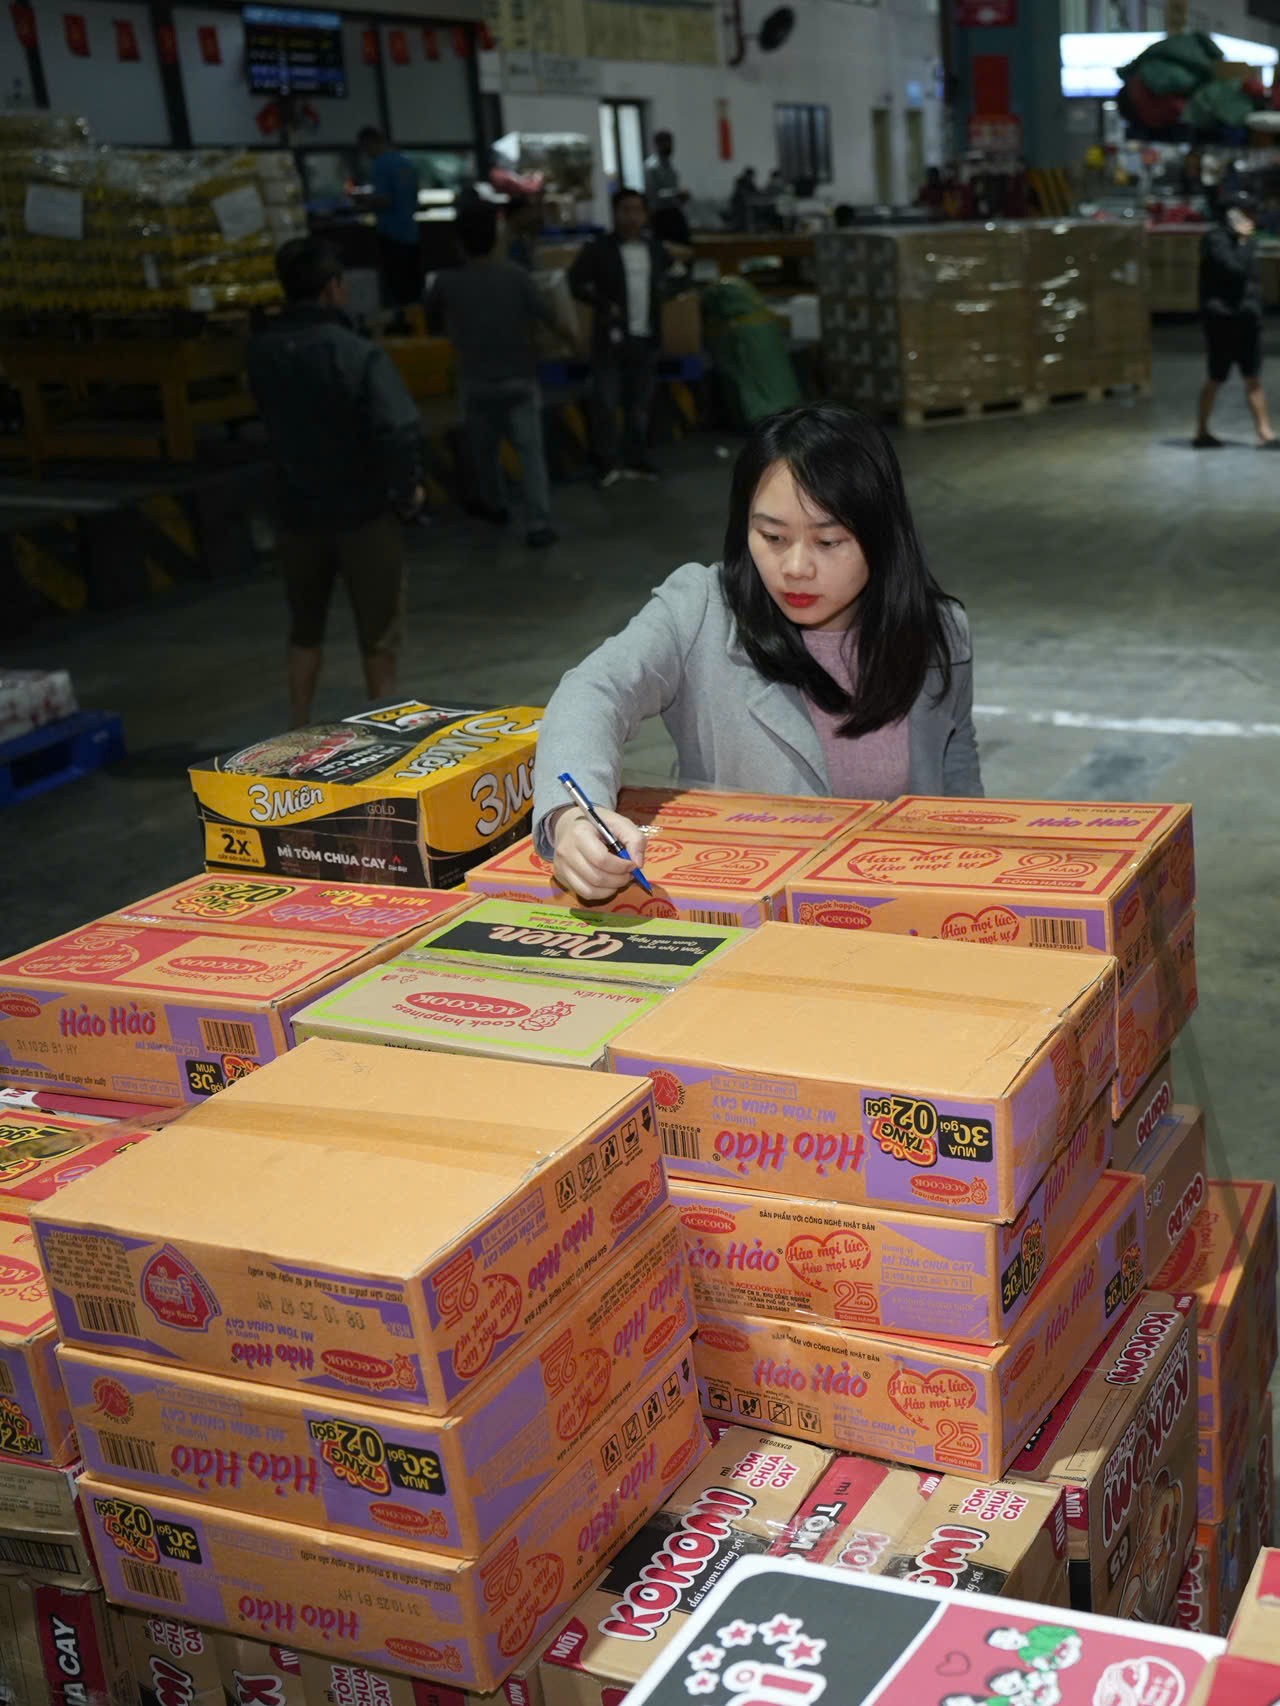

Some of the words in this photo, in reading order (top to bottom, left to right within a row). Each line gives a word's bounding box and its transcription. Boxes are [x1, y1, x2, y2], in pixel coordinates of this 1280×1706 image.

[366, 804, 396, 816] GOLD
[277, 844, 293, 858] MÌ
[294, 848, 321, 862] TÔM
[324, 854, 358, 868] CHUA
[360, 856, 387, 870] CAY
[487, 925, 624, 960] Quen
[59, 1003, 107, 1038] Hảo
[108, 1001, 156, 1036] Hảo
[391, 1003, 465, 1027] happiness
[471, 1017, 516, 1029] Cook
[892, 1093, 938, 1137] 02
[713, 1129, 788, 1174] Hảo
[793, 1131, 866, 1175] Hảo
[948, 1144, 978, 1158] MUA
[231, 1342, 274, 1370] Hảo
[275, 1344, 314, 1371] Hảo
[1105, 1309, 1179, 1386] KOKOMI
[753, 1357, 806, 1393] Hảo
[811, 1361, 868, 1398] Hảo
[336, 1418, 386, 1466] 02
[935, 1418, 982, 1458] 25
[171, 1444, 244, 1494] Hảo
[249, 1451, 321, 1496] Hảo
[402, 1475, 430, 1492] MUA
[720, 1464, 731, 1477] mì
[731, 1451, 766, 1482] TÔM
[747, 1453, 786, 1490] CHUA
[769, 1461, 801, 1492] CAY
[961, 1486, 992, 1517] TÔM
[977, 1488, 1012, 1523] CHUA
[1000, 1494, 1029, 1523] CAY
[167, 1545, 191, 1560] MUA
[598, 1486, 757, 1642] KOKOMI
[238, 1595, 297, 1633] Hảo
[301, 1604, 361, 1642] Hảo
[50, 1614, 82, 1677] CAY
[550, 1631, 584, 1659] MỚI
